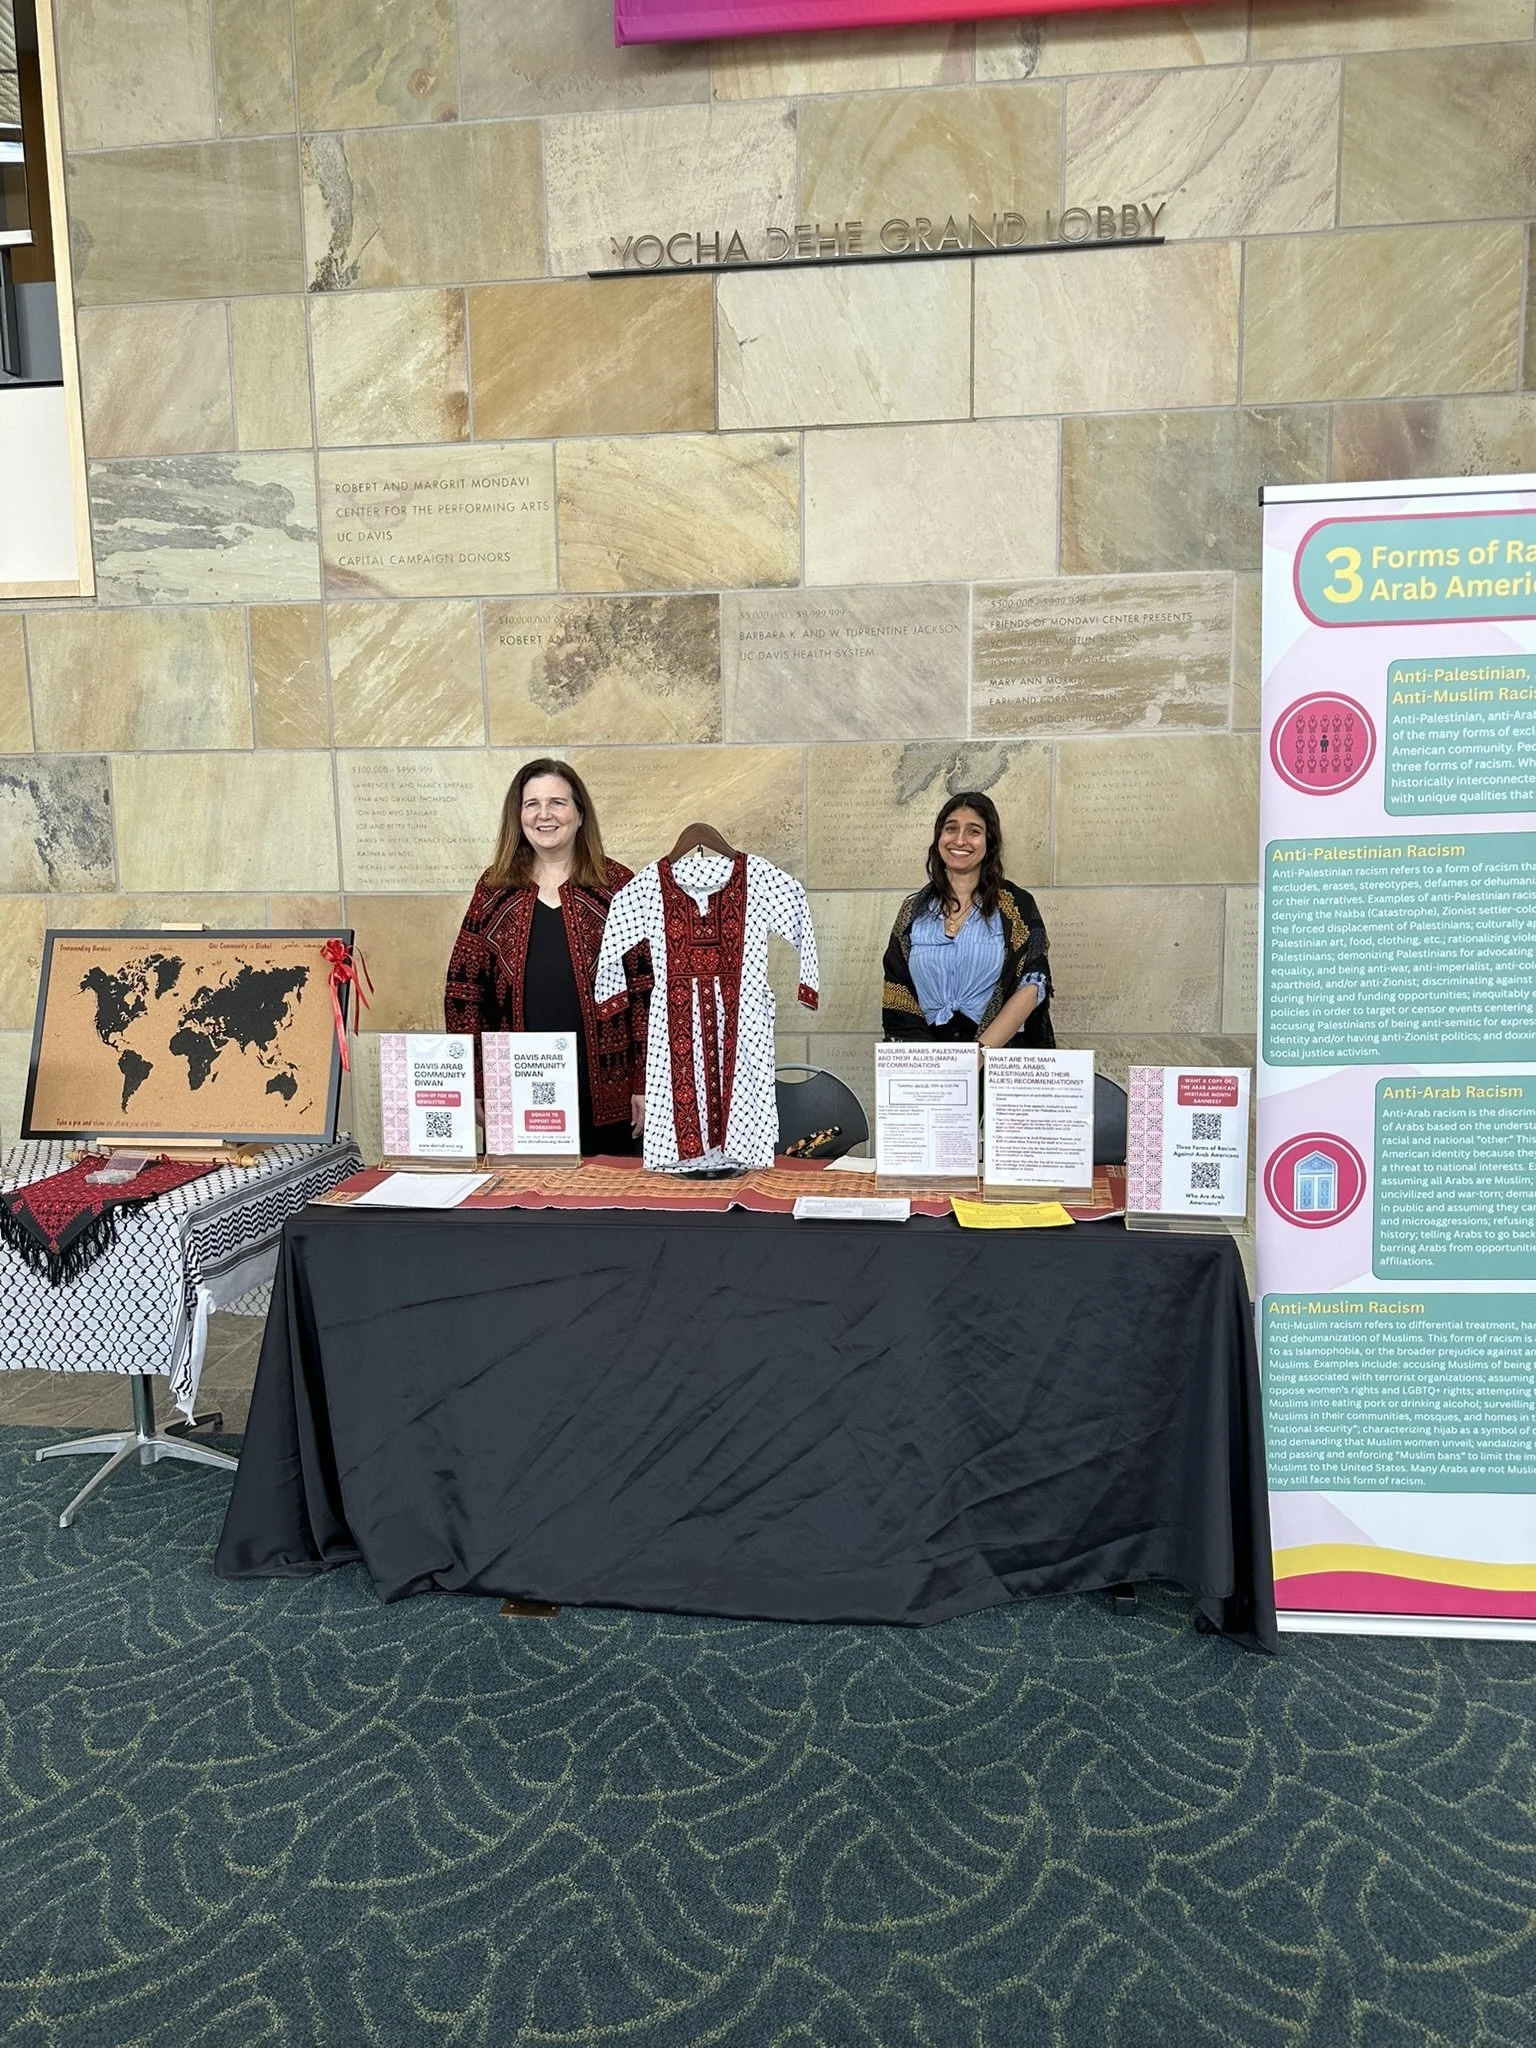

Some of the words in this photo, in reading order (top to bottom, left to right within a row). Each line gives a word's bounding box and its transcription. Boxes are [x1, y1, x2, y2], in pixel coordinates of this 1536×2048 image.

[611, 229, 749, 269] YOCHA
[766, 221, 863, 261] DEHE
[879, 212, 1028, 254] GRAND
[1046, 202, 1166, 243] LOBBY
[335, 483, 377, 493] ROBERT
[384, 481, 408, 491] AND
[414, 479, 465, 490] MARGRIT
[471, 477, 530, 488] MONDAVI
[336, 508, 380, 518] CENTER
[385, 506, 407, 516] FOR
[413, 505, 432, 515] THE
[439, 502, 515, 514] PERFORMING
[521, 501, 549, 511] ARTS
[337, 532, 353, 542] UC
[358, 531, 392, 541] DAVIS
[339, 556, 384, 566] CAPITAL
[390, 554, 453, 565] CAMPAIGN
[460, 552, 511, 563] DONORS
[1372, 543, 1459, 569] Forms
[1468, 539, 1499, 564] of
[1323, 546, 1363, 604] 3
[1370, 575, 1437, 602] Arab
[1445, 571, 1536, 599] Ameri
[991, 619, 1030, 629] FRIENDS
[1033, 618, 1046, 626] OF
[1051, 616, 1098, 626] MONDAVI
[1103, 615, 1139, 624] CENTER
[1143, 612, 1192, 622] PRESENTS
[739, 632, 785, 641] BARBARA
[803, 629, 825, 639] AND
[844, 626, 908, 637] TURRENTINE
[913, 624, 961, 635] JACKSON
[500, 636, 542, 645] ROBERT
[740, 652, 753, 660] UC
[759, 651, 789, 660] DAVIS
[794, 650, 831, 659] HEALTH
[836, 648, 874, 657] SYSTEM
[1393, 666, 1531, 683] Anti-Palestinian,
[989, 678, 1017, 687] MARY
[1020, 677, 1042, 685] ANN
[1392, 687, 1493, 704] Anti-Muslim
[1392, 711, 1485, 724] Anti-Palestinian,
[1392, 729, 1404, 740] of
[1406, 729, 1425, 739] the
[1428, 730, 1459, 741] many
[1462, 727, 1495, 737] forms
[1497, 726, 1510, 736] of
[1512, 725, 1535, 736] excl
[1391, 744, 1445, 756] American
[1447, 742, 1513, 756] community.
[1391, 761, 1421, 771] three
[1424, 760, 1457, 770] forms
[1460, 759, 1472, 769] of
[1475, 758, 1514, 768] racism.
[1391, 776, 1453, 789] historically
[1390, 793, 1414, 803] with
[1417, 791, 1457, 804] unique
[1459, 790, 1507, 802] qualities
[1509, 789, 1533, 799] that
[1272, 845, 1401, 861] Anti-Palestinian
[1407, 843, 1465, 857] Racism
[1270, 1048, 1300, 1057] social
[1301, 1048, 1334, 1059] justice
[1336, 1047, 1380, 1056] activism.
[1383, 1085, 1460, 1098] Anti-Arab
[1466, 1084, 1522, 1097] Racism
[1379, 1256, 1434, 1265] affiliations.
[1269, 1301, 1363, 1313] Anti-Muslim
[1368, 1301, 1424, 1313] Racism
[1268, 1477, 1288, 1487] may
[1290, 1475, 1307, 1484] still
[1310, 1475, 1330, 1483] face
[1332, 1475, 1351, 1484] this
[1353, 1476, 1376, 1484] form
[1378, 1476, 1388, 1484] of
[1391, 1476, 1425, 1485] racism.
